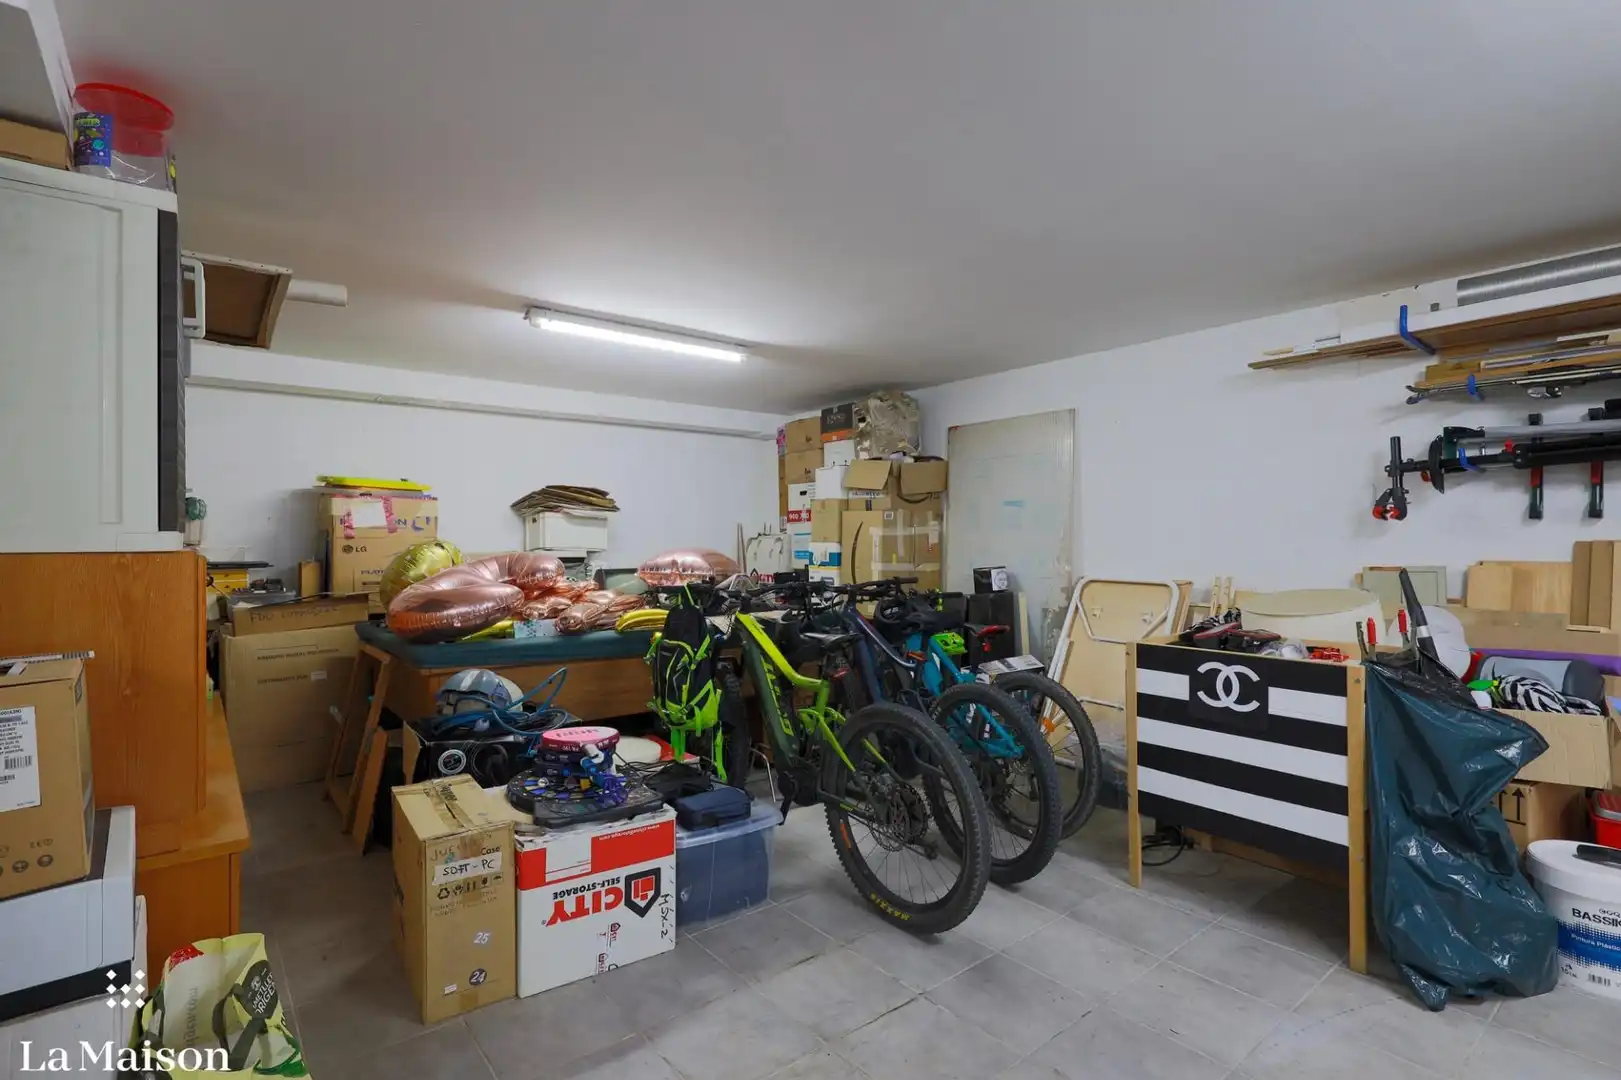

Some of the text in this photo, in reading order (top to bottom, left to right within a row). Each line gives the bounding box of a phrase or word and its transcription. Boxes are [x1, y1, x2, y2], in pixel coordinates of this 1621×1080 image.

[442, 863, 470, 876] SOFT
[481, 859, 495, 870] PC
[552, 876, 621, 900] SELF-STORAGE
[545, 886, 624, 927] CITY
[473, 931, 492, 944] 25
